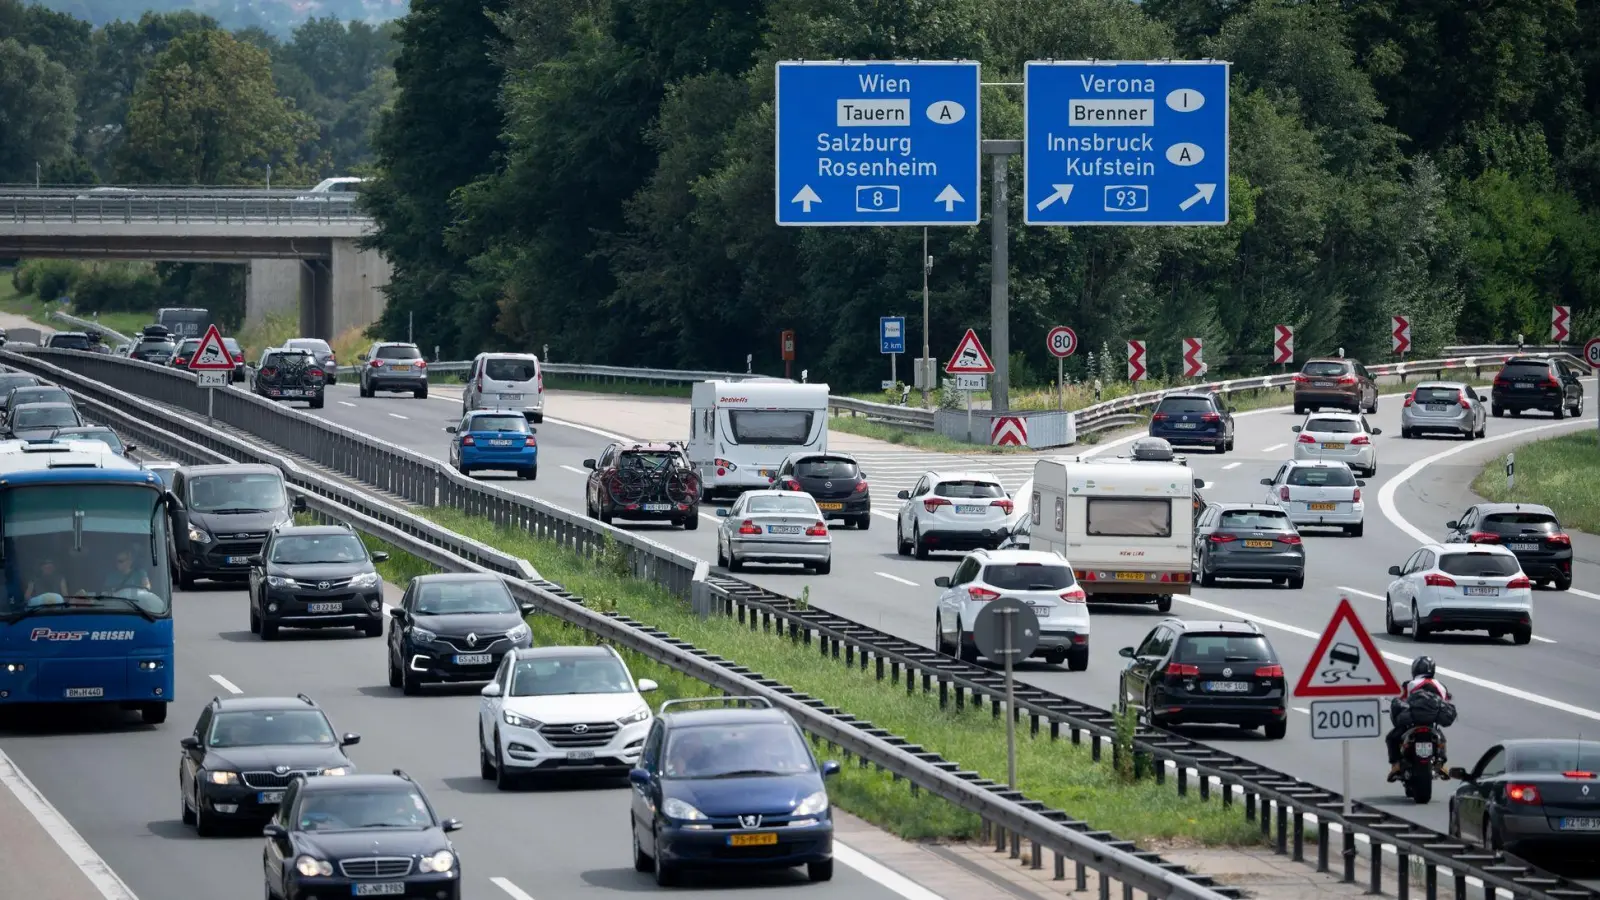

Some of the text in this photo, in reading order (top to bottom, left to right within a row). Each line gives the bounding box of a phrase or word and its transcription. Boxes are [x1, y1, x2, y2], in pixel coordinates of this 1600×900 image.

[858, 74, 911, 93] Wien
[1080, 74, 1155, 93] Verona
[843, 105, 904, 120] Tauern
[939, 105, 951, 120] A
[1074, 105, 1148, 120] Brenner
[817, 133, 911, 156] Salzburg
[1047, 132, 1154, 151] Innsbruck
[1179, 147, 1191, 162] A
[818, 158, 937, 176] Rosenheim
[1066, 158, 1155, 176] Kufstein
[873, 191, 883, 206] 8
[1116, 191, 1136, 206] 93
[890, 341, 902, 349] km
[1054, 335, 1071, 348] 80
[30, 627, 136, 641] Paas REISEN
[458, 654, 468, 663] GS
[481, 654, 490, 662] 33
[88, 687, 102, 696] 440
